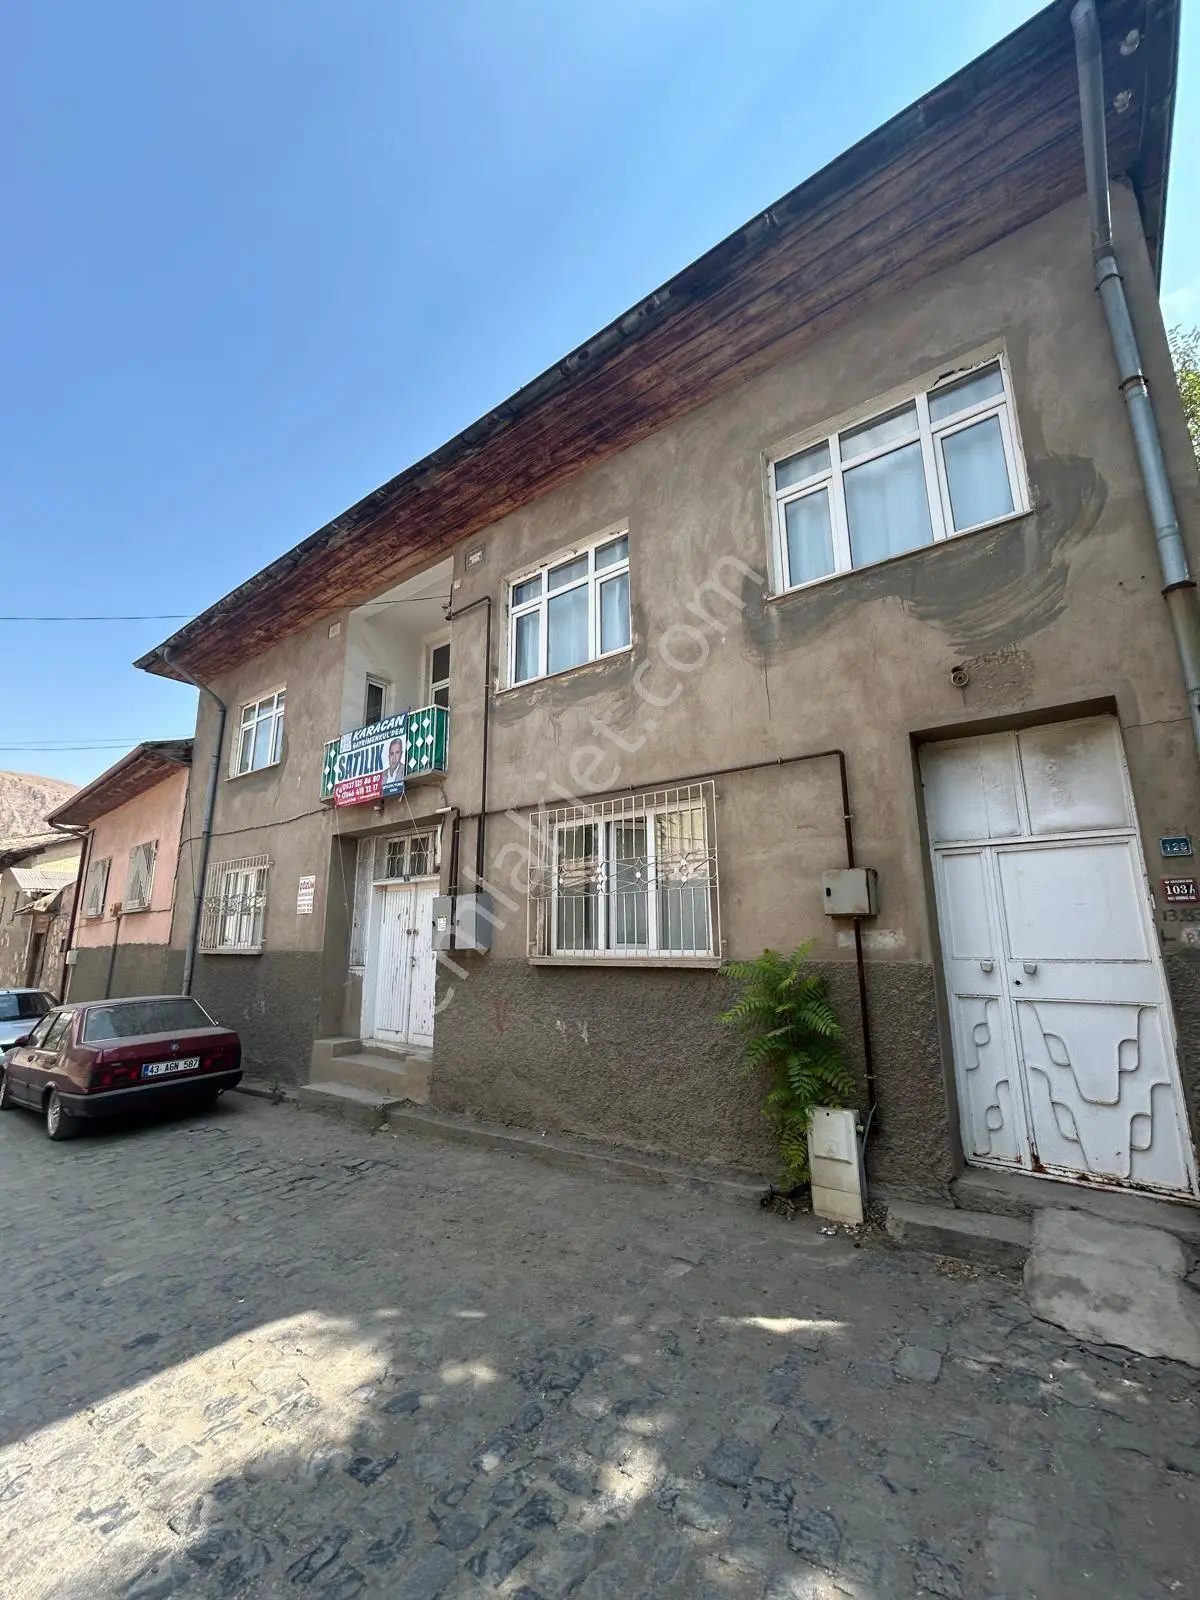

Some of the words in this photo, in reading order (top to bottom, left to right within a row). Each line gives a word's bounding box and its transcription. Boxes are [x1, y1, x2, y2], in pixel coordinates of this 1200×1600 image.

[353, 714, 405, 741] KARACAN
[338, 743, 384, 781] SATILIK
[149, 1066, 159, 1074] 43
[164, 1061, 180, 1072] AGN
[183, 1059, 198, 1069] 587
